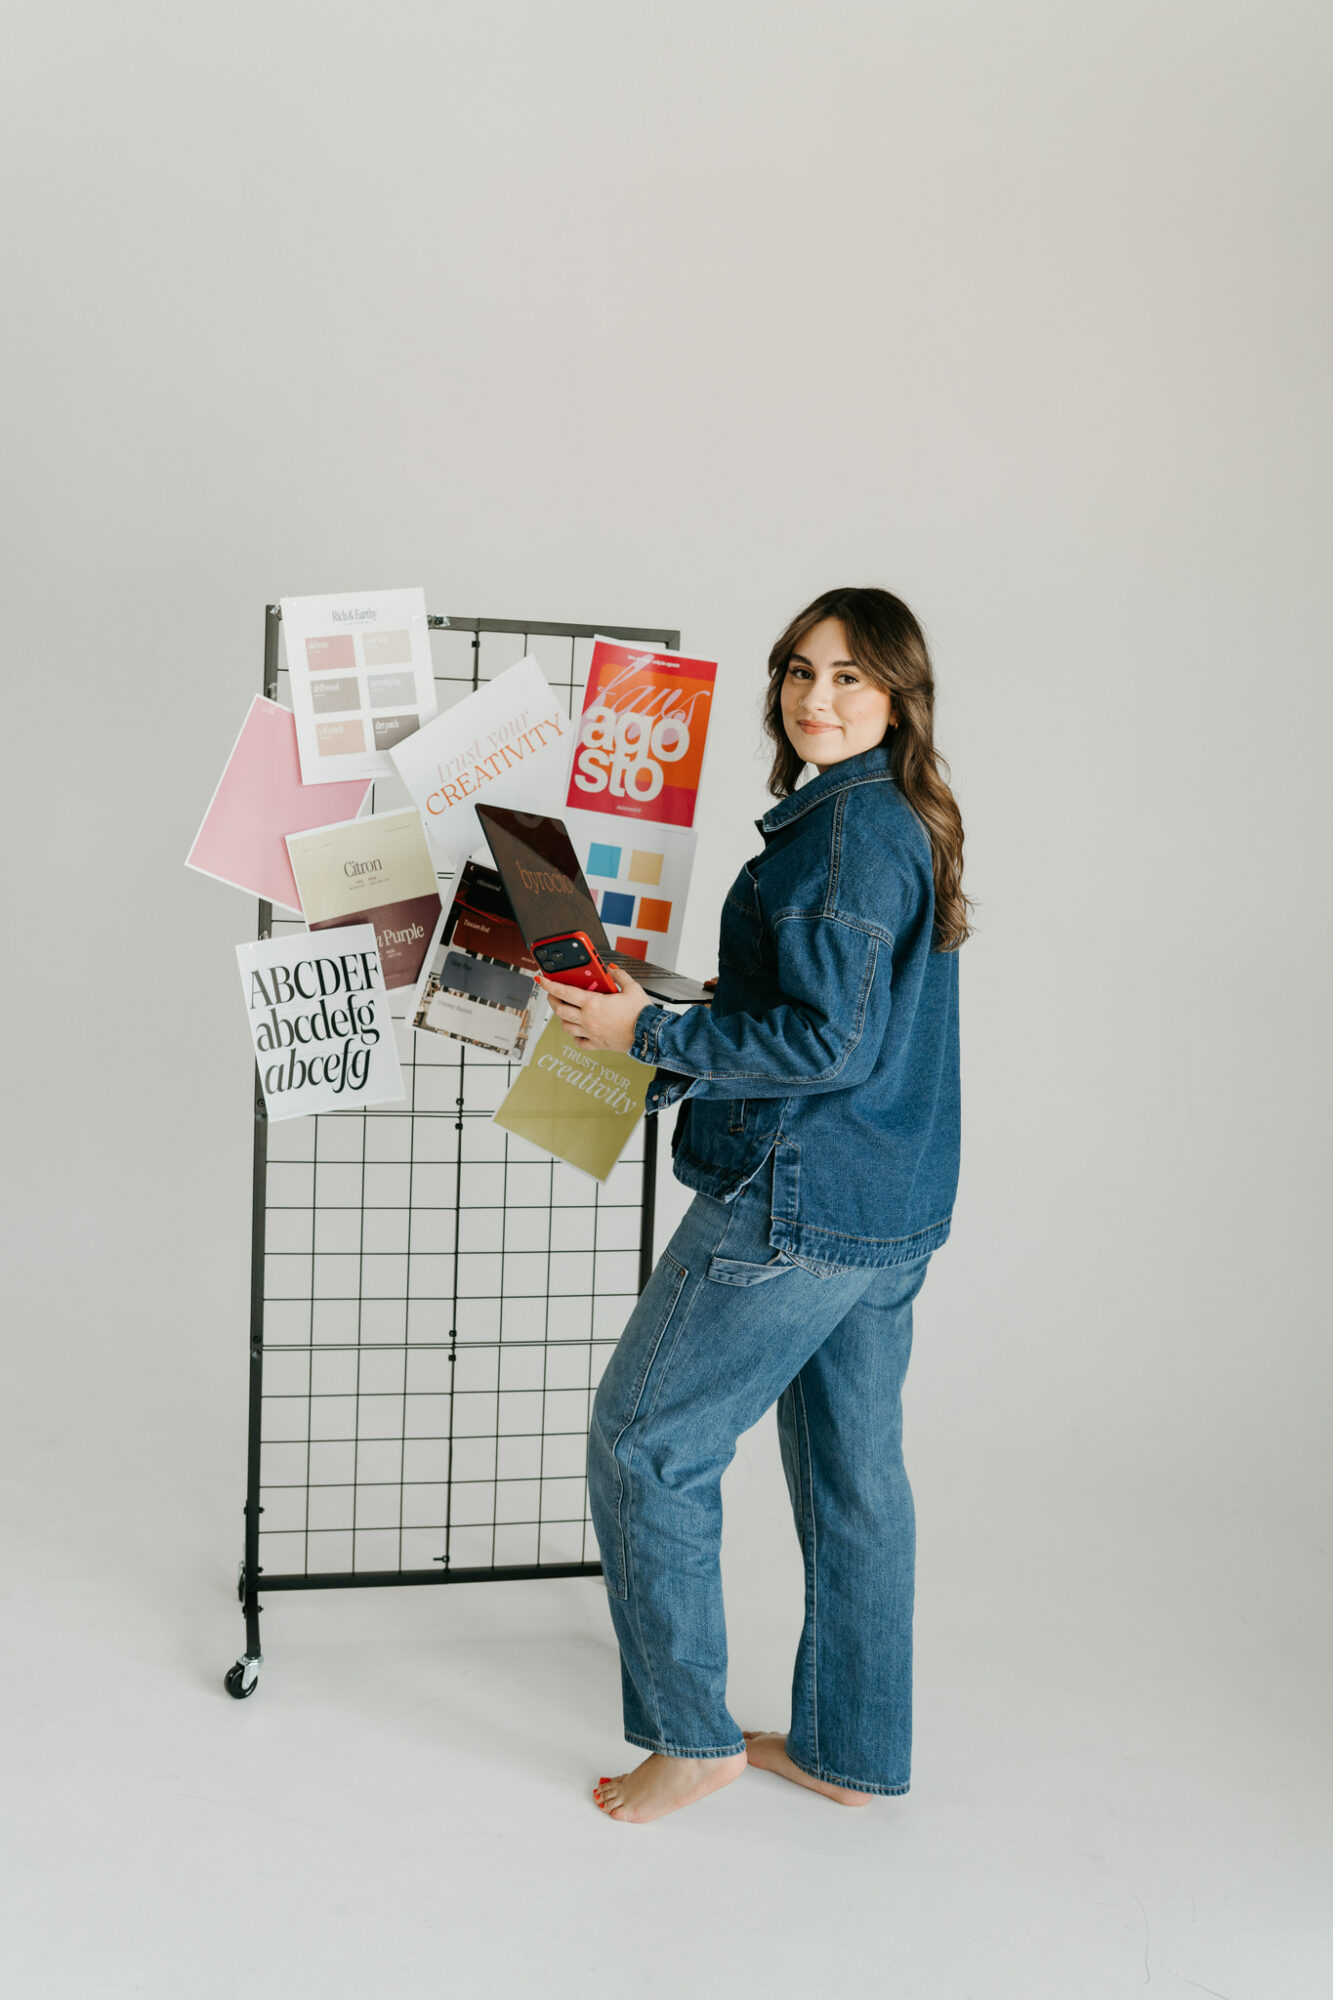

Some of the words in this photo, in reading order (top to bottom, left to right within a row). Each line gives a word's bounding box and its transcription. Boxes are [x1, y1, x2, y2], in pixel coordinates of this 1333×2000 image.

[436, 739, 484, 784] trust
[486, 710, 529, 748] your
[581, 705, 690, 764] ago
[426, 713, 564, 816] CREATIVITY
[574, 744, 664, 802] sto
[344, 858, 383, 878] Citron
[383, 922, 425, 947] Purple
[250, 951, 379, 1010] ABCDEF
[256, 994, 380, 1051] abcdefg
[264, 1038, 371, 1094] abcefg
[537, 1054, 637, 1115] creativity
[562, 1045, 599, 1071] TRUST
[600, 1065, 631, 1090] YOUR
